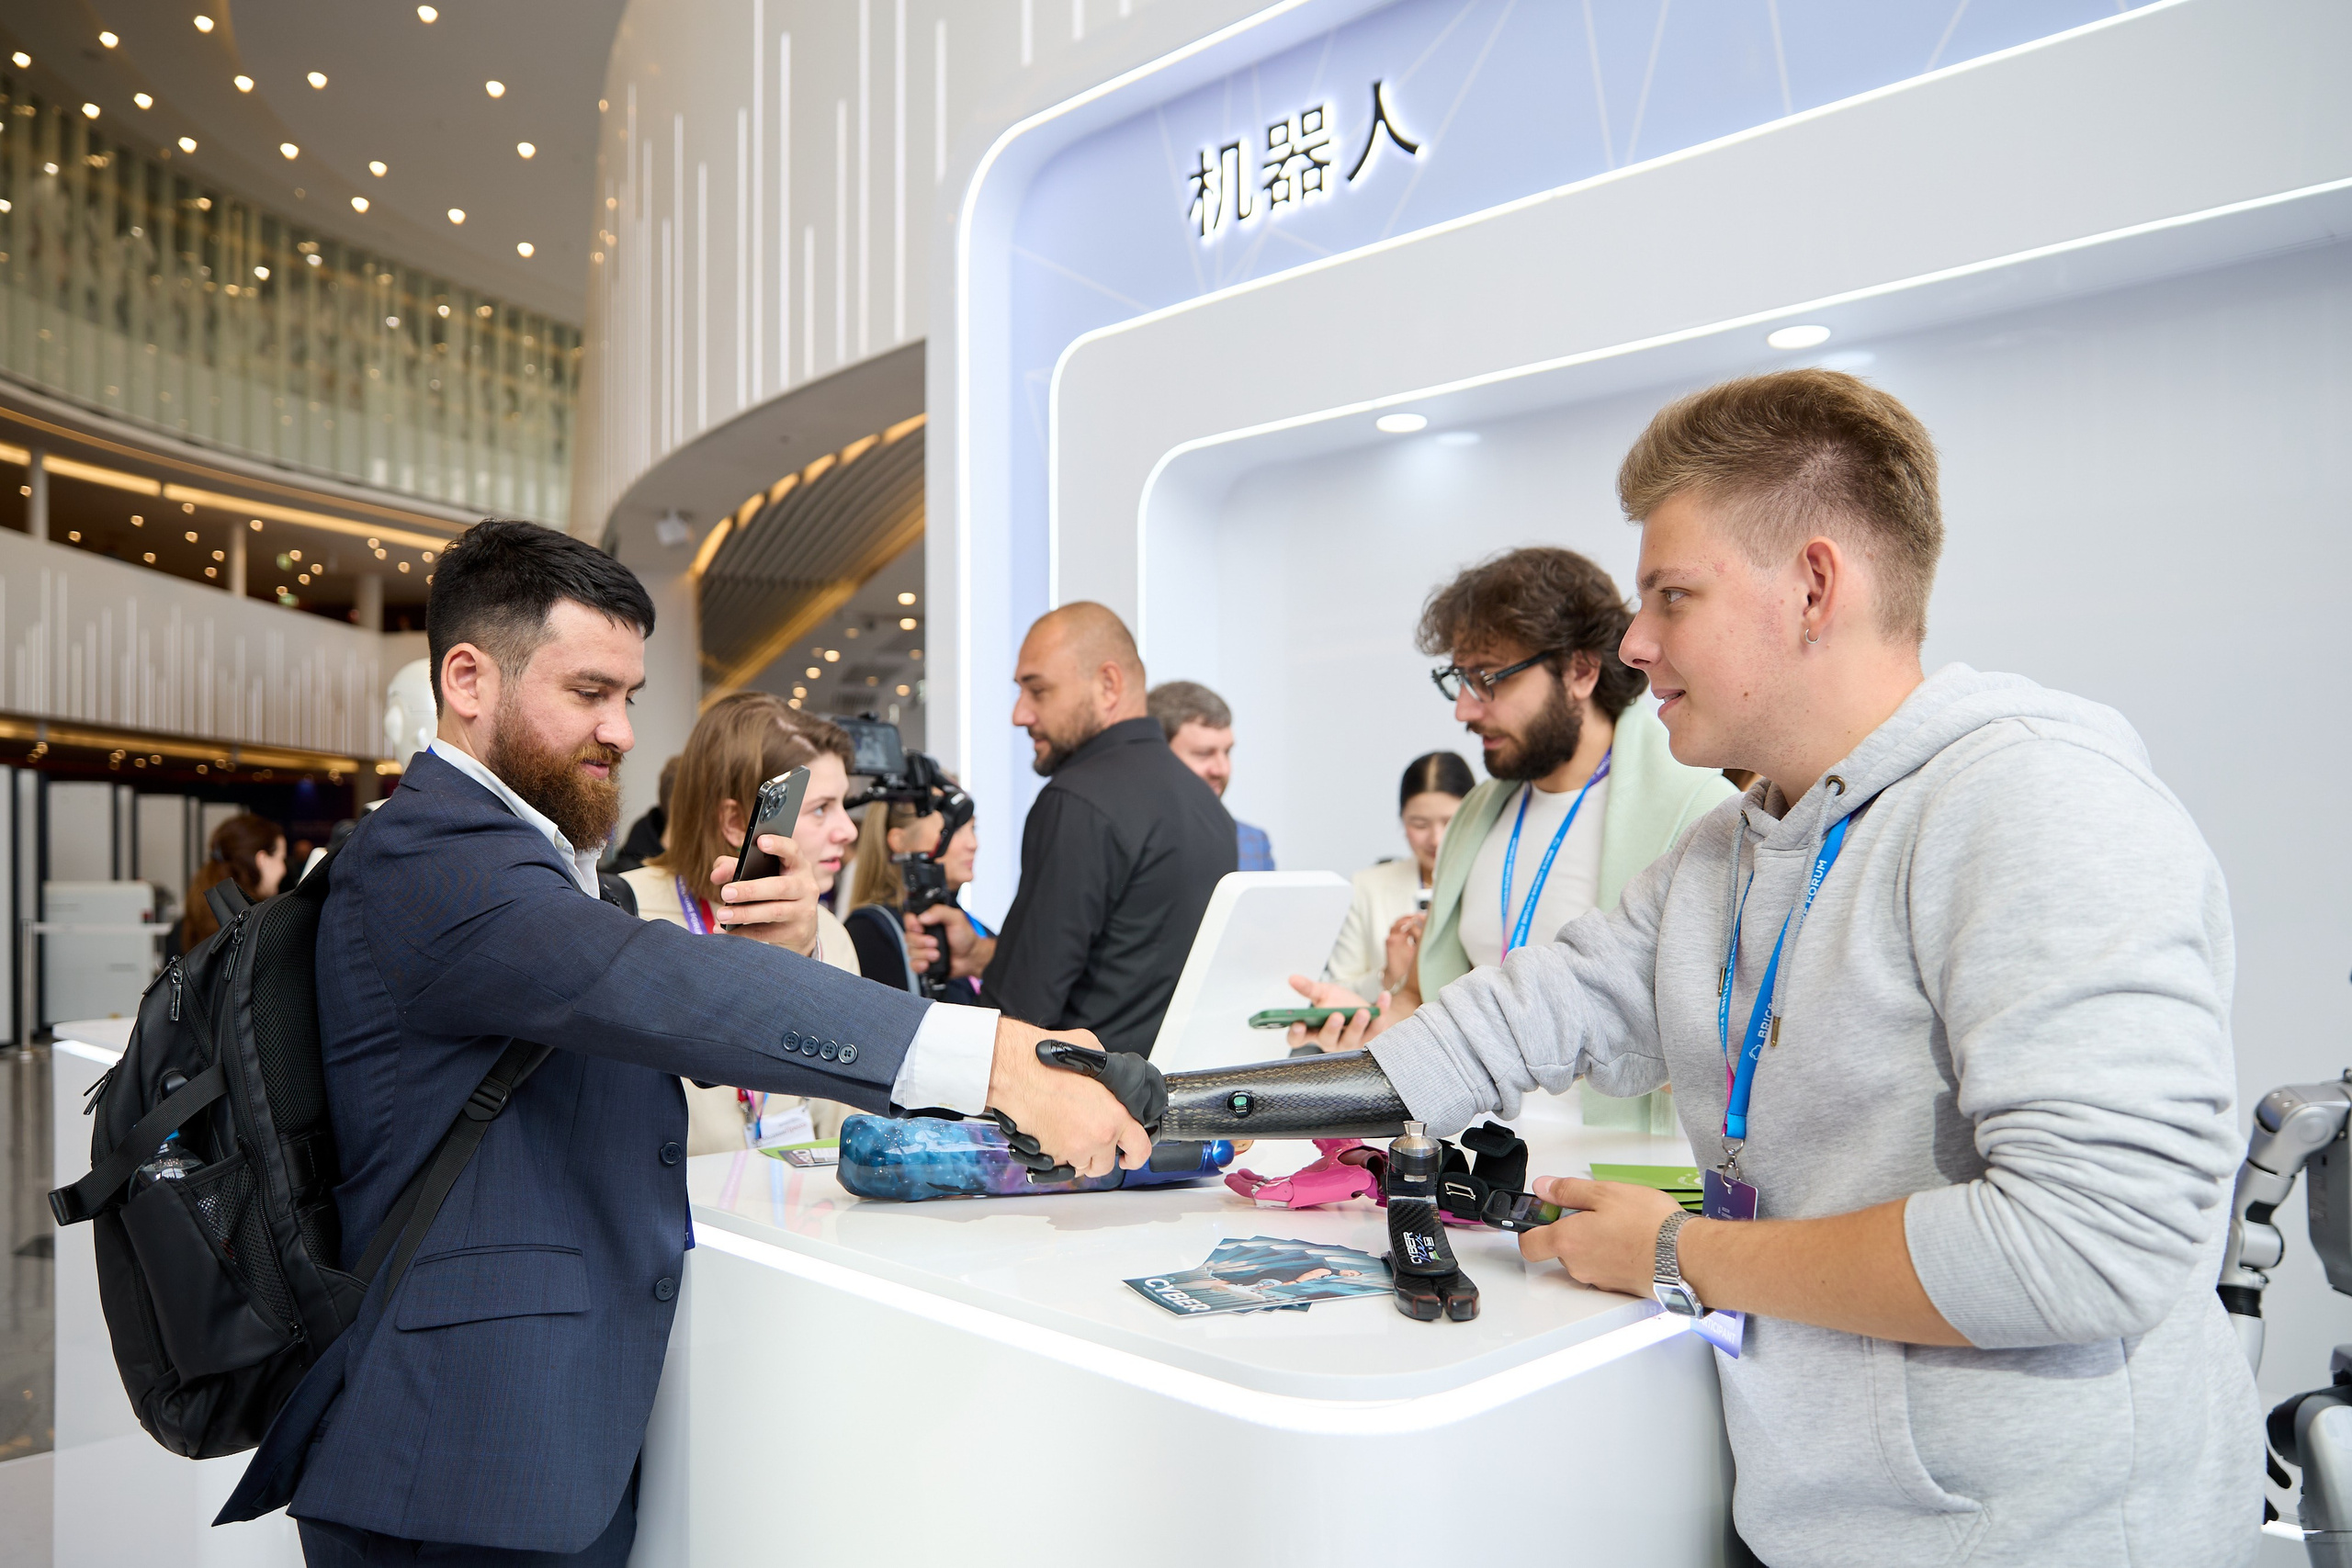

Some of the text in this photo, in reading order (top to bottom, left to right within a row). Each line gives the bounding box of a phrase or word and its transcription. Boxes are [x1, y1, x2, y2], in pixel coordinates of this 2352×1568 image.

[1188, 80, 1420, 238] 机器人
[1806, 859, 1827, 903] FORUM
[1403, 1231, 1422, 1264] CYBER
[1144, 1278, 1212, 1313] CYBER
